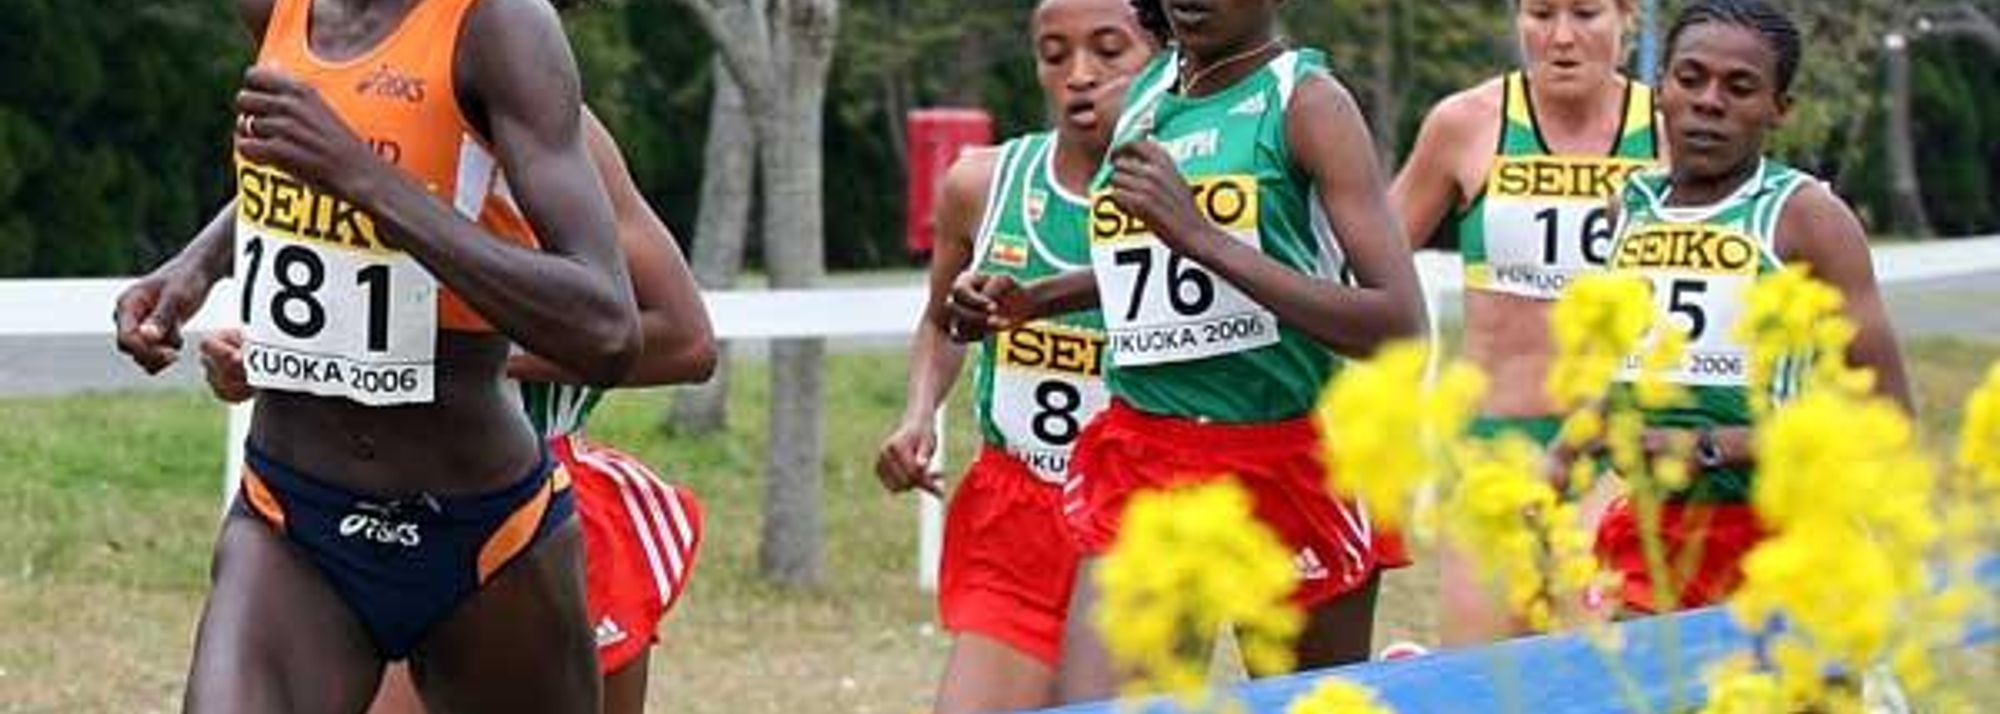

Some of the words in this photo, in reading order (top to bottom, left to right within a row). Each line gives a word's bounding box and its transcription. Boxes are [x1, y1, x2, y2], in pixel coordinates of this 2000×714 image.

[1498, 161, 1644, 197] SEIK
[240, 166, 384, 249] SEIK
[1534, 207, 1613, 266] 16
[1618, 231, 1752, 269] SEIKO
[241, 235, 391, 353] 181
[1114, 247, 1215, 322] 76
[1202, 313, 1265, 343] 2006
[350, 366, 419, 393] 2006
[1690, 355, 1742, 375] 2006
[1032, 379, 1081, 446] 8
